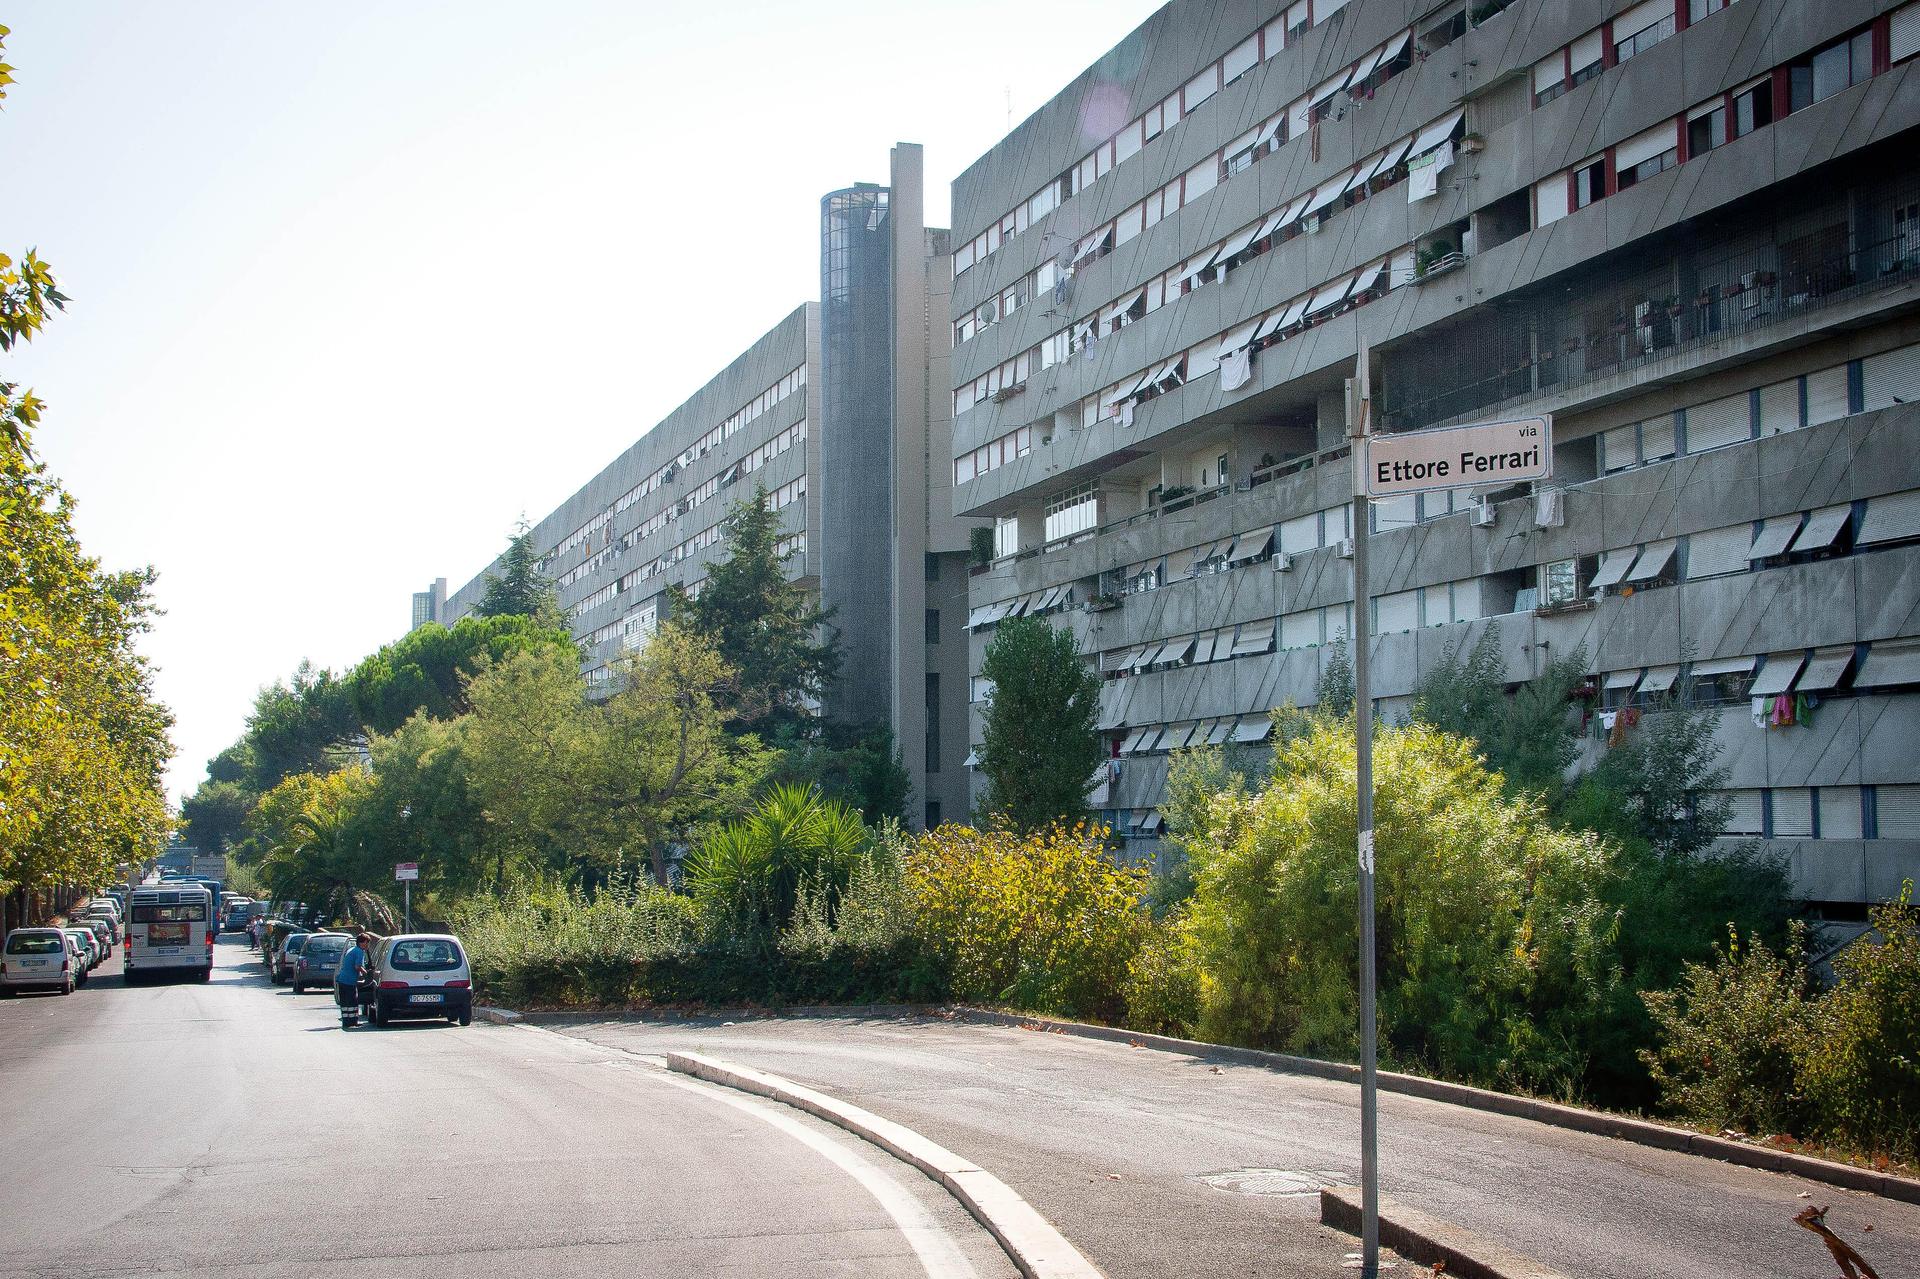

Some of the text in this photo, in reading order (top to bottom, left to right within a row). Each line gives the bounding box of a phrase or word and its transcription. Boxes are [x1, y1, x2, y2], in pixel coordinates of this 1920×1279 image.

[1518, 425, 1537, 438] via
[1377, 444, 1539, 483] Ettore Ferrari
